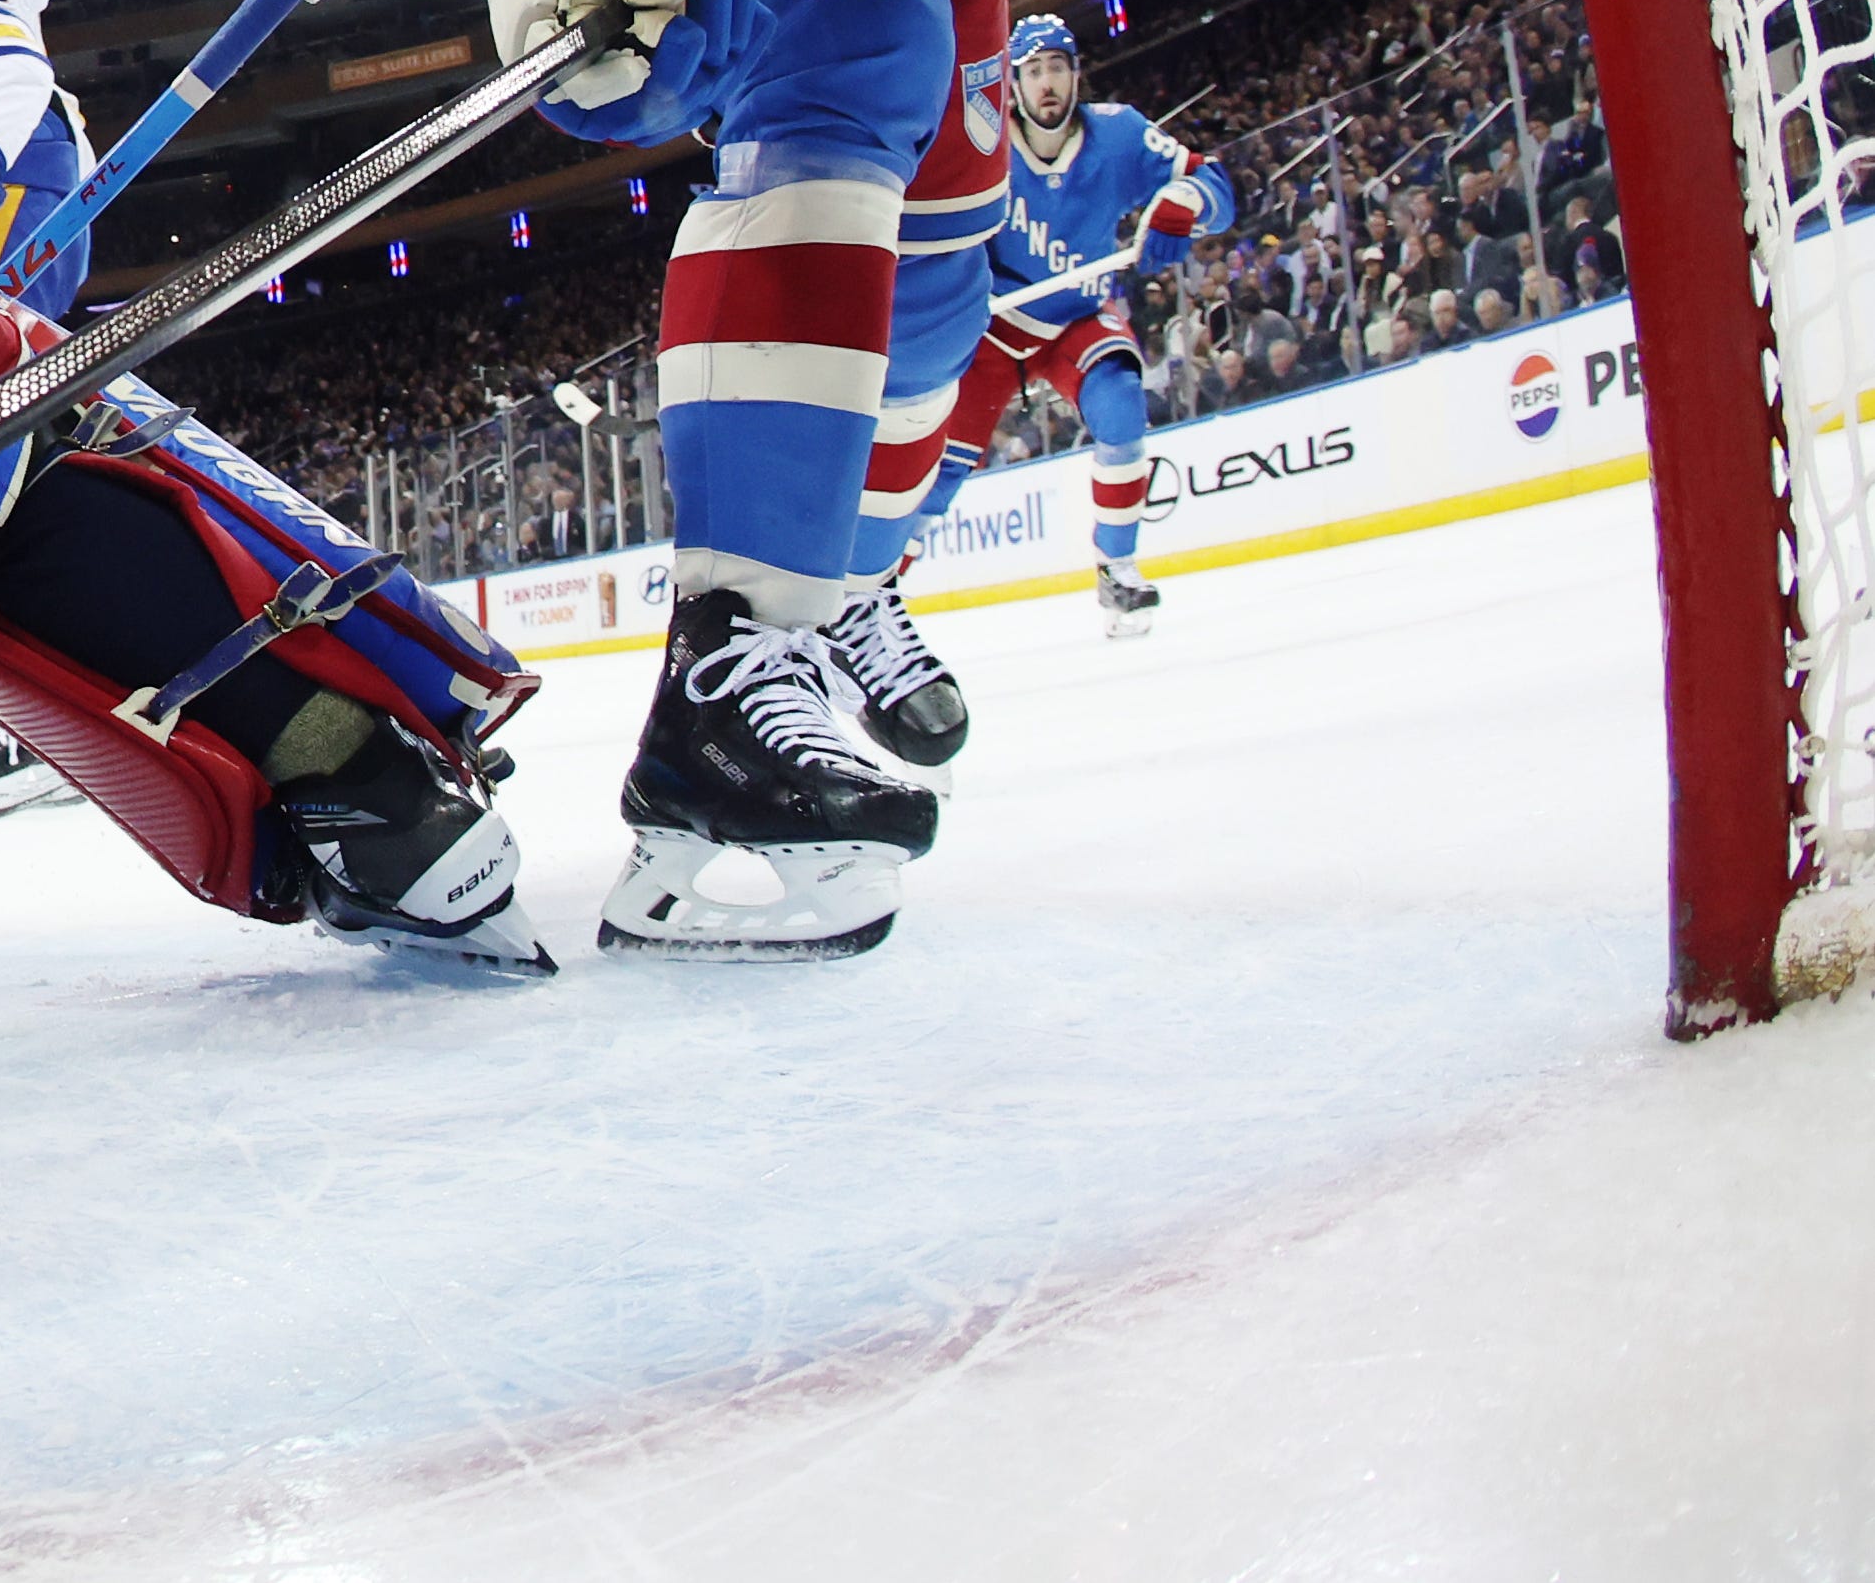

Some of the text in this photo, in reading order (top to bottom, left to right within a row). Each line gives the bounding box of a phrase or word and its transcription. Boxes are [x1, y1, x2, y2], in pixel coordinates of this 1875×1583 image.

[80, 160, 126, 206] RTL
[1511, 382, 1560, 410] PEPSI
[1189, 428, 1355, 496] LEXUS
[701, 743, 749, 791] BAUER
